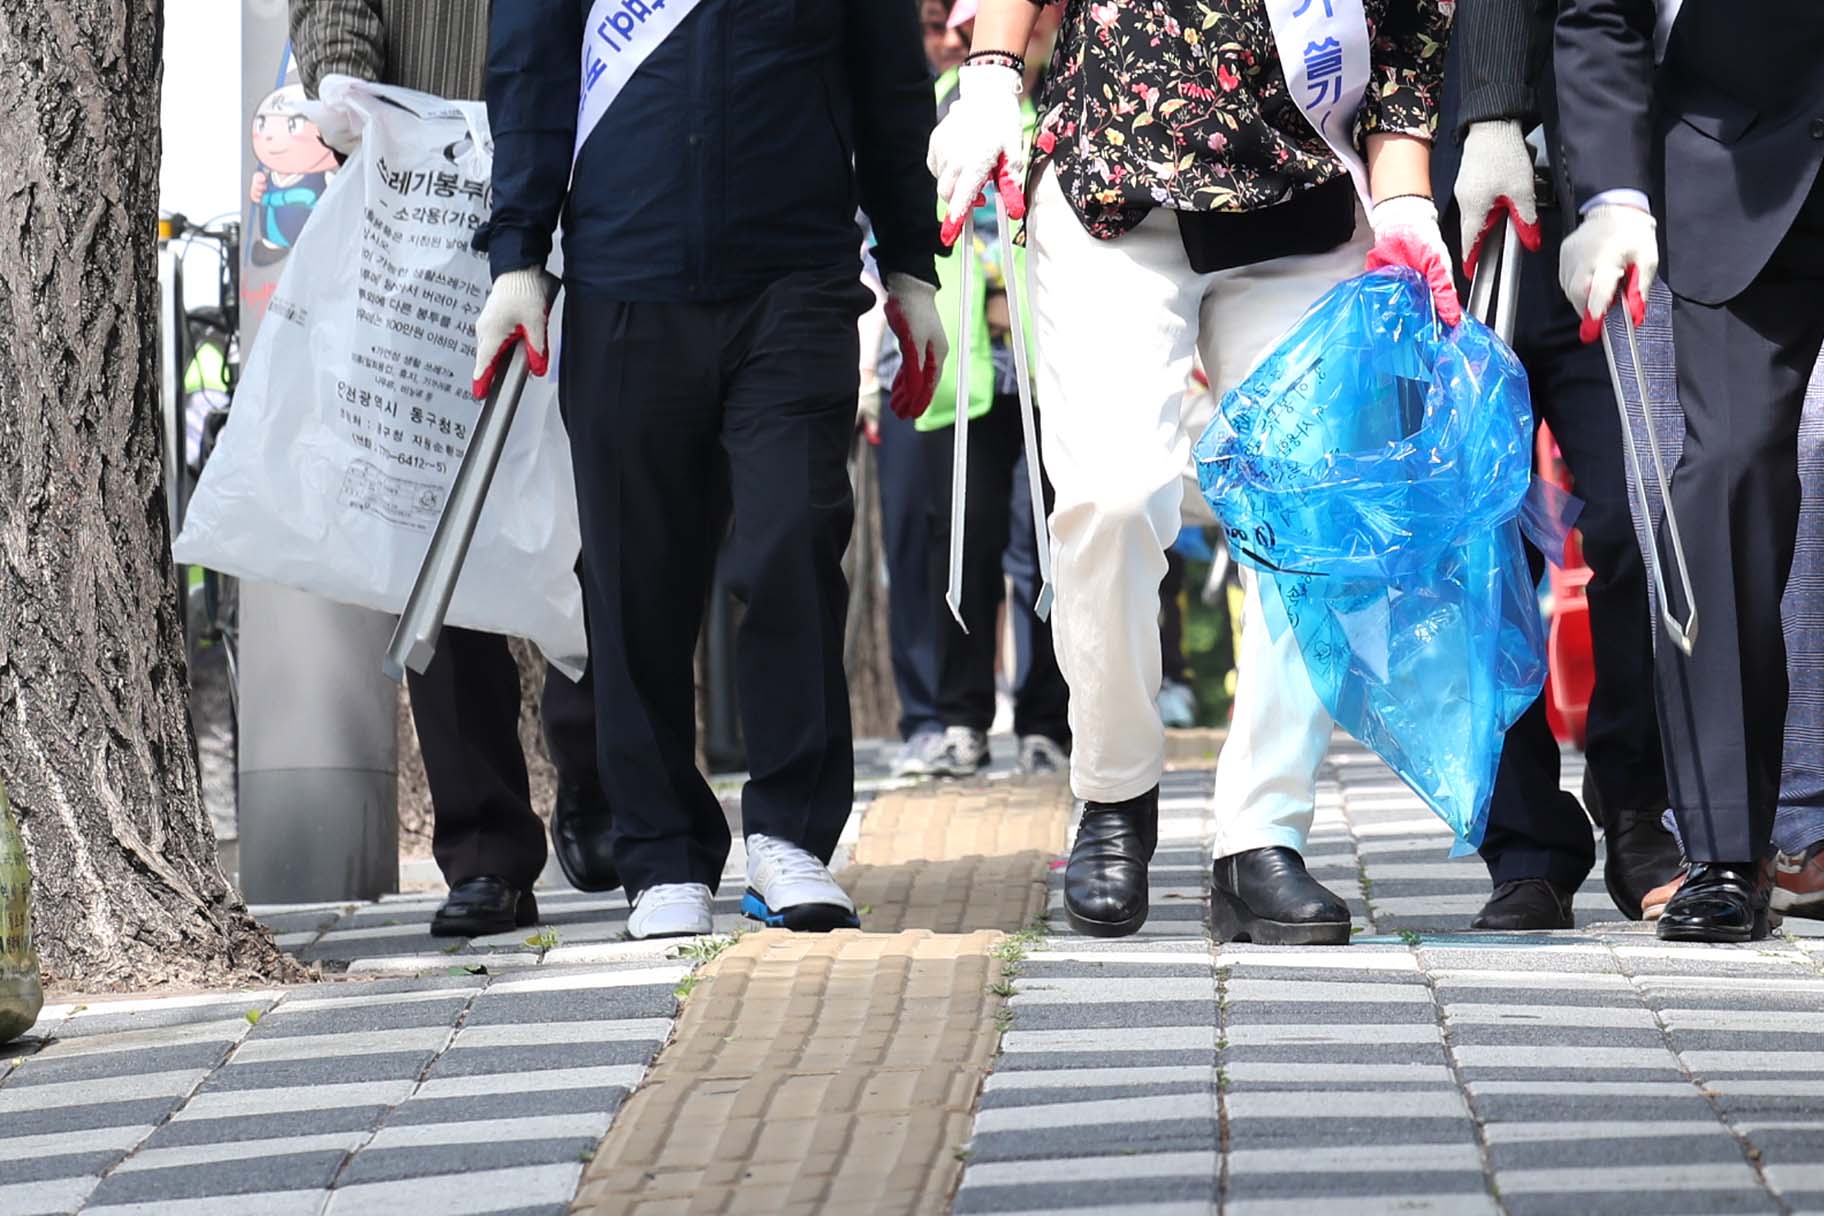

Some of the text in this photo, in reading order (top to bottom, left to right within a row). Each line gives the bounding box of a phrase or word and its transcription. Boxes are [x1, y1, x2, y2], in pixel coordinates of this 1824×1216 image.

[422, 289, 458, 309] 버려야
[389, 297, 413, 316] 다른
[416, 306, 452, 329] 봉투를
[427, 332, 458, 351] 이하의
[409, 406, 467, 440] 동구청장
